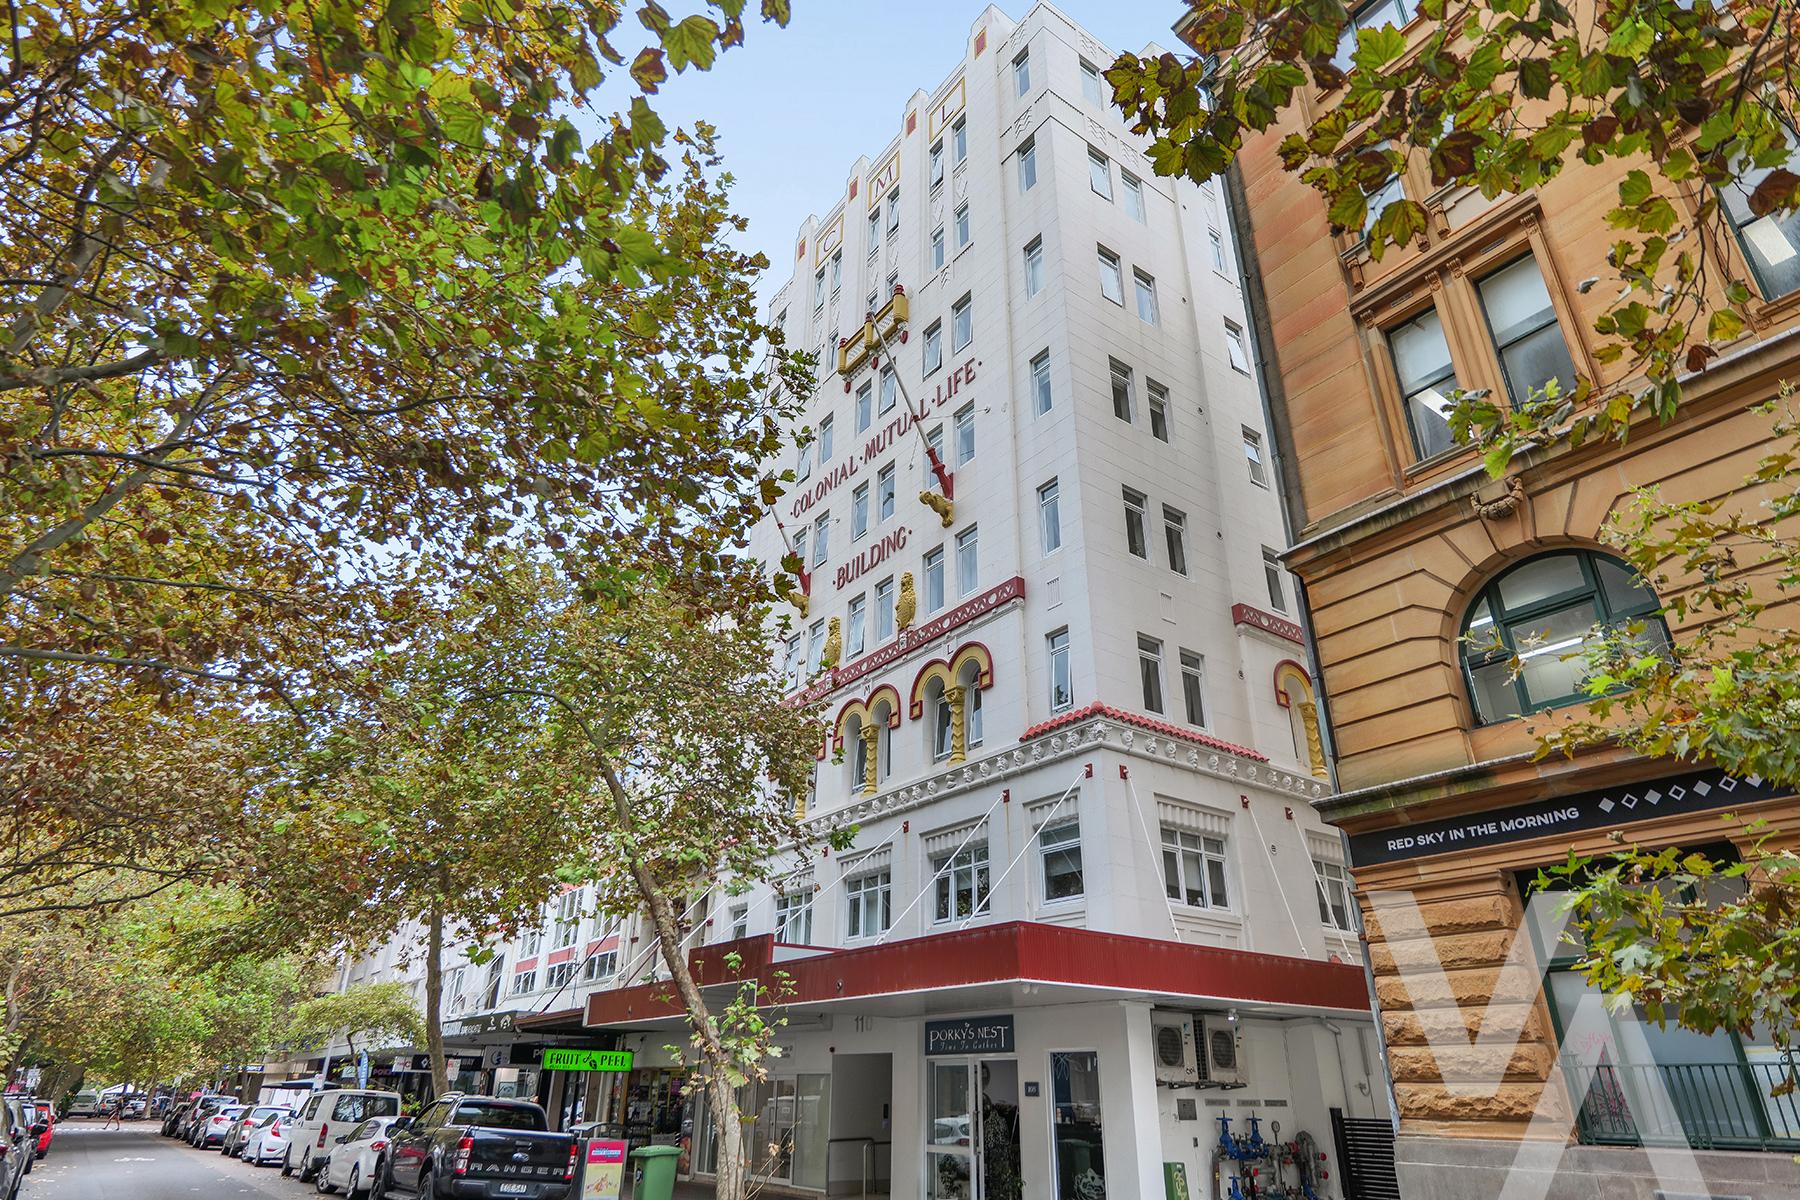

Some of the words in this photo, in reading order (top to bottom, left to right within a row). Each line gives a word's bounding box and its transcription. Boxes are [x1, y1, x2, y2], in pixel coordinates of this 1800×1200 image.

[941, 104, 954, 124] L
[874, 167, 893, 197] M
[823, 230, 836, 252] C
[1387, 836, 1414, 851] RED
[1416, 831, 1445, 846] SKY
[1449, 828, 1465, 841] IN
[1466, 822, 1498, 837] THE
[1500, 807, 1580, 833] MORNING
[930, 1022, 975, 1051] PORKY'S
[977, 1025, 1009, 1049] NEST
[549, 1053, 581, 1065] FRUIT
[600, 1054, 626, 1067] PEEL
[470, 1162, 565, 1176] RANGER
